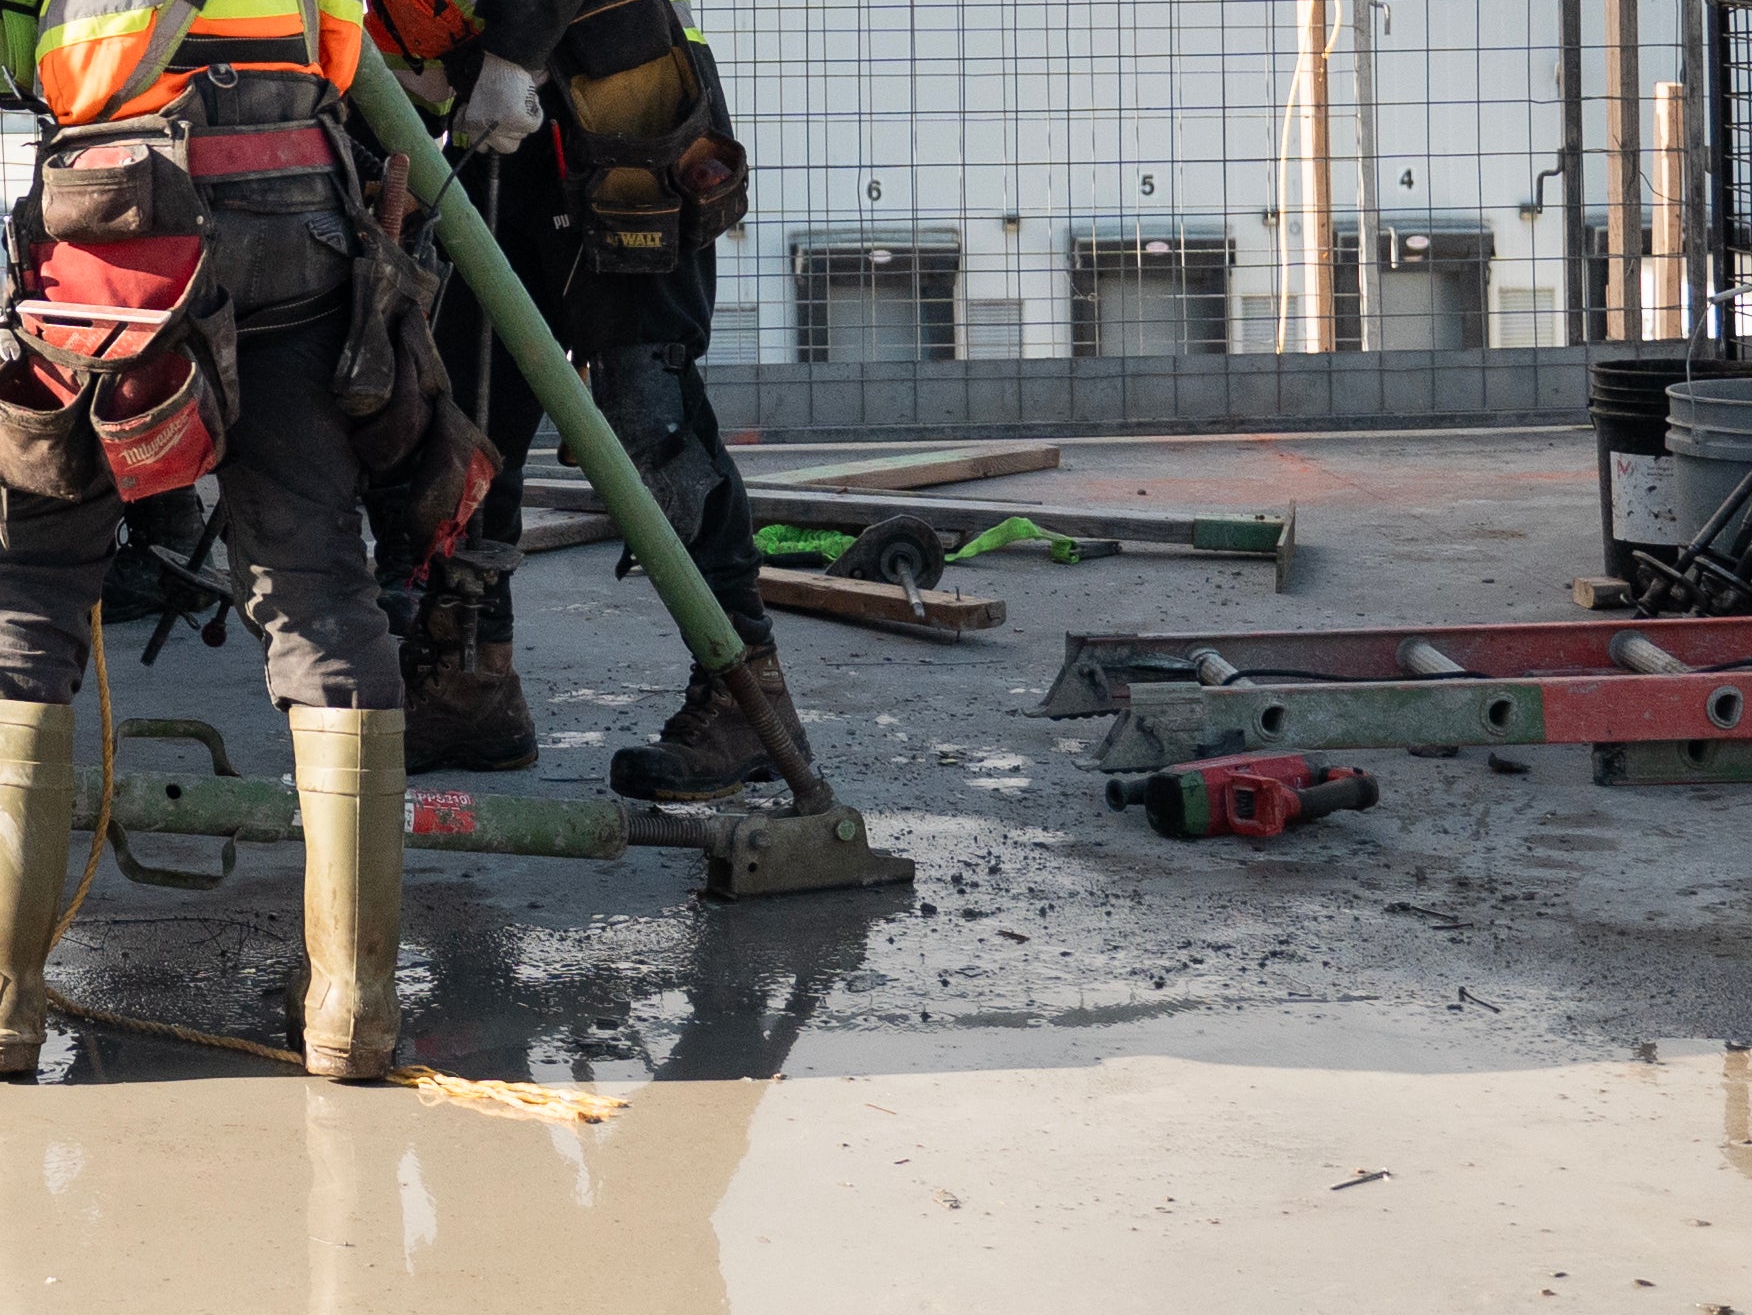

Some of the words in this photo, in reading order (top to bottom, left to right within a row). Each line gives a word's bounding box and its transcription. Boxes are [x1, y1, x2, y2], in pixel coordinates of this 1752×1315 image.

[1140, 174, 1155, 196] 5
[1399, 168, 1414, 190] 4
[866, 179, 882, 202] 6
